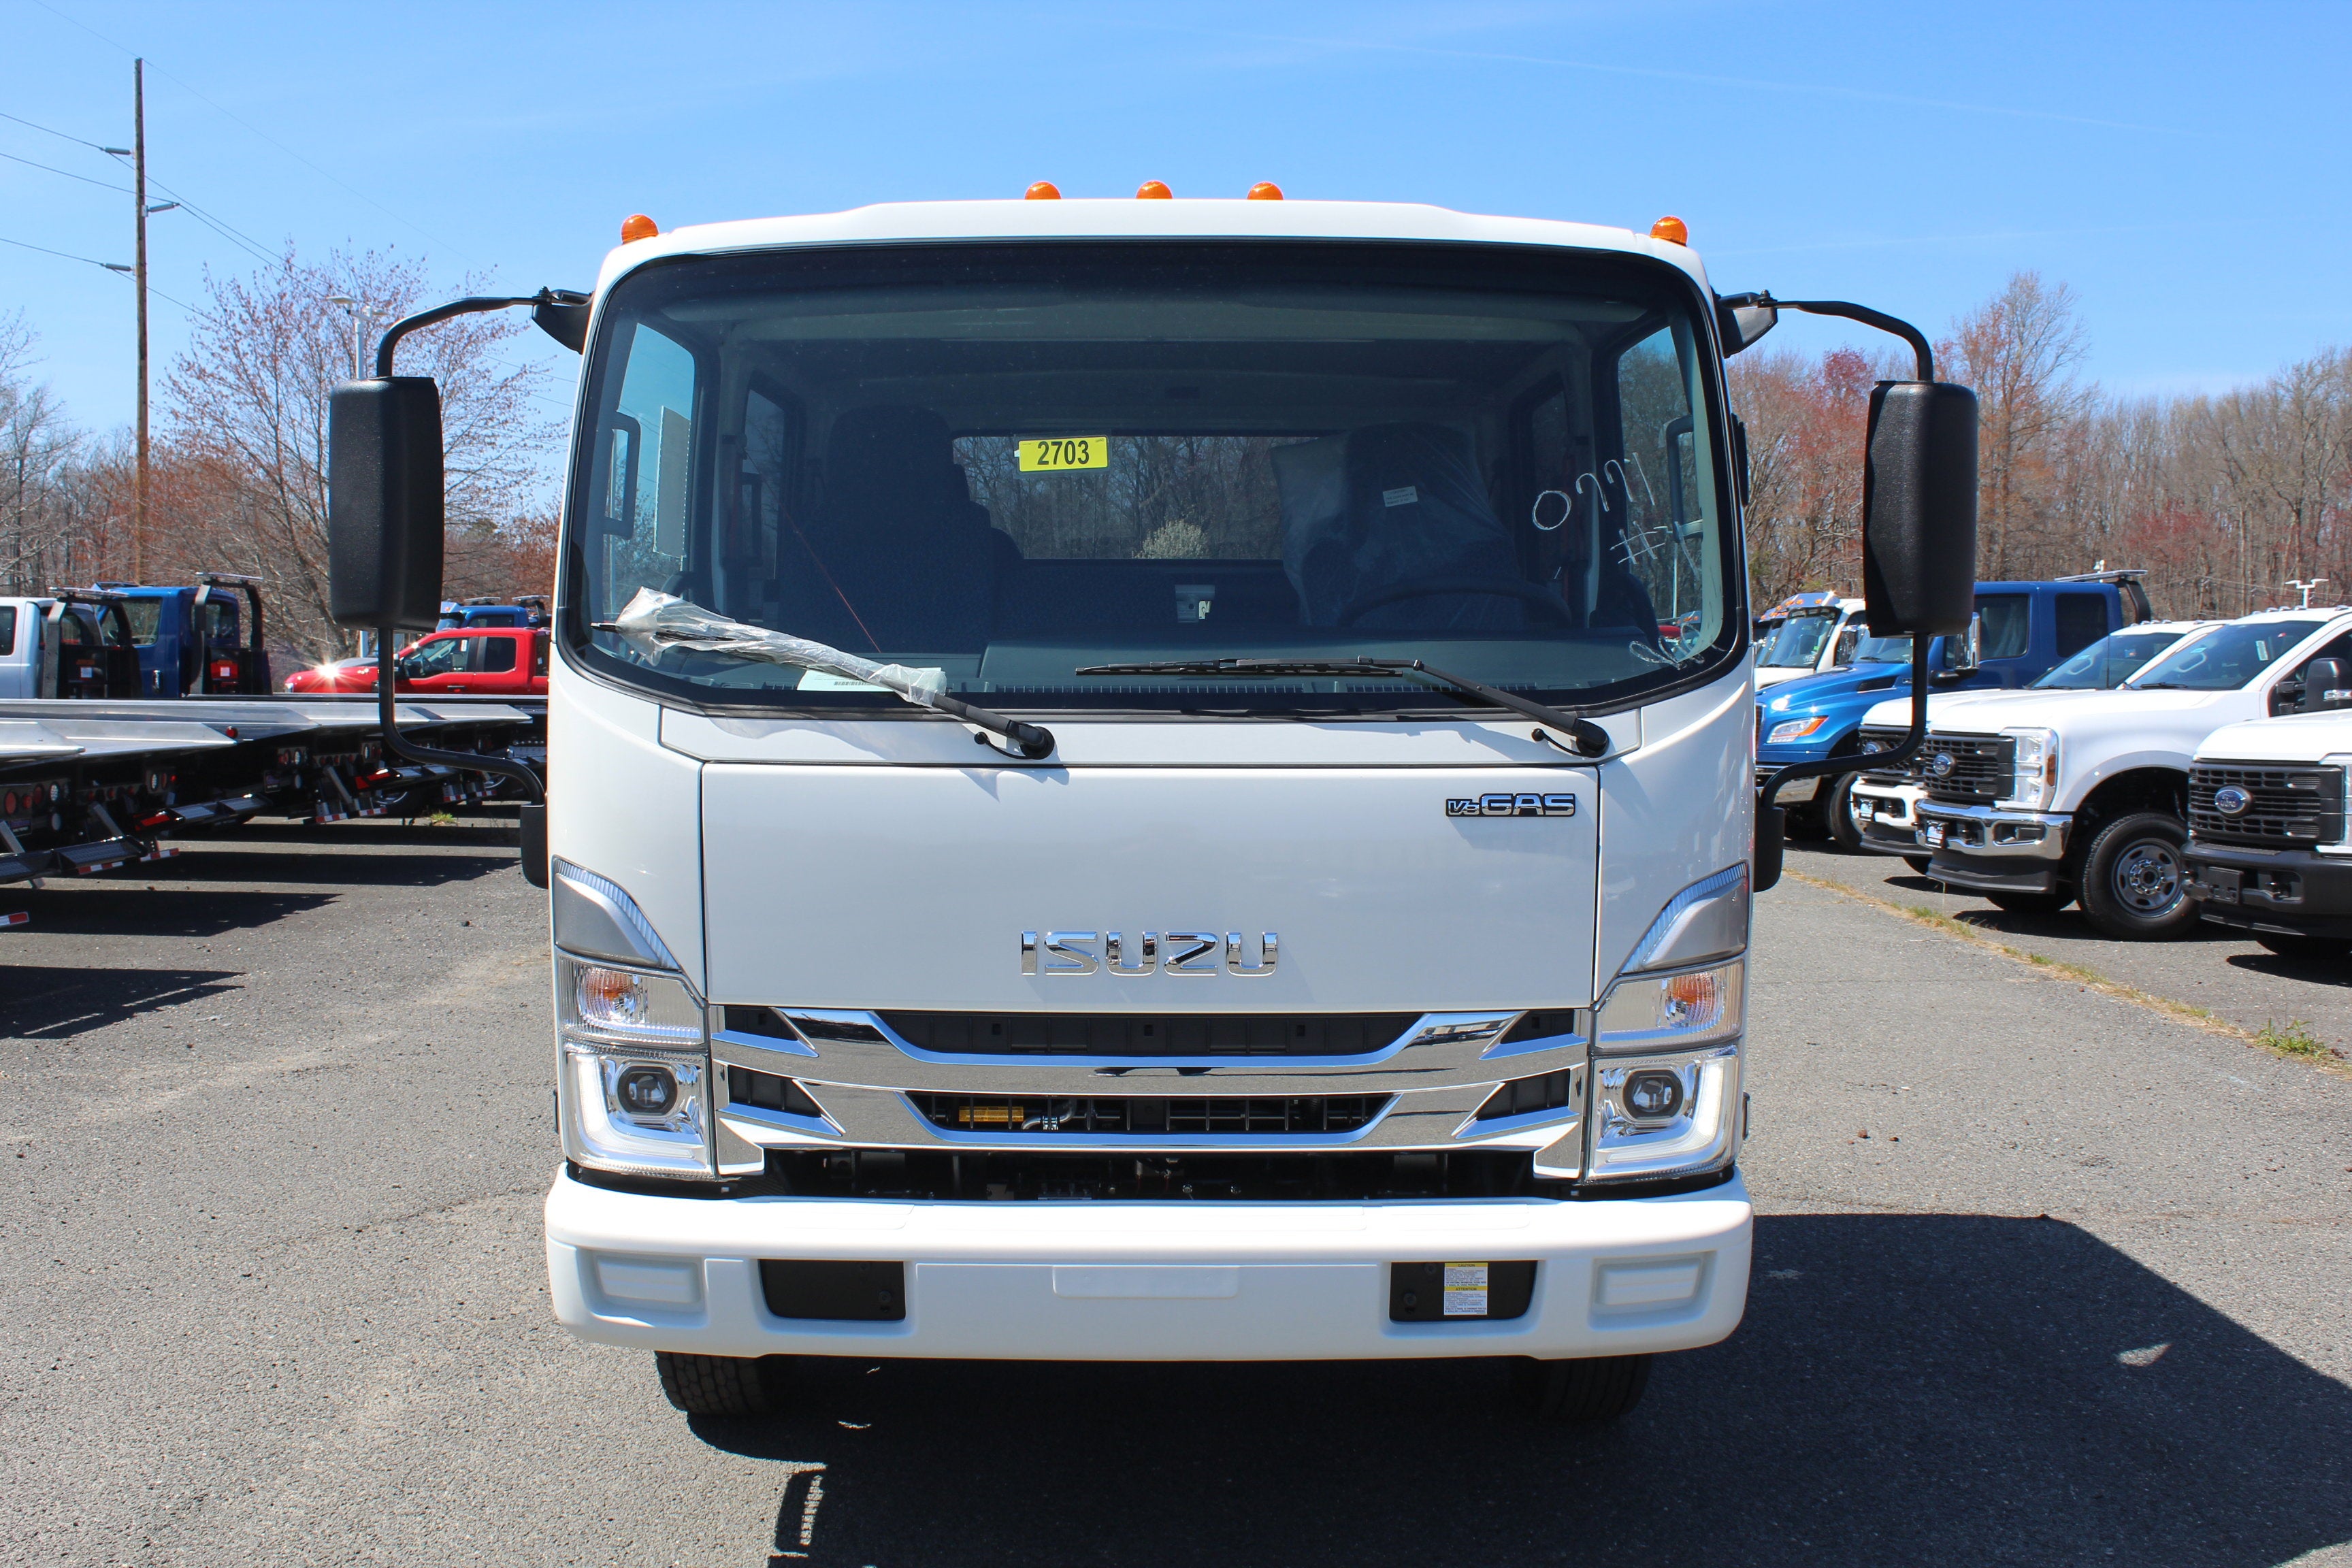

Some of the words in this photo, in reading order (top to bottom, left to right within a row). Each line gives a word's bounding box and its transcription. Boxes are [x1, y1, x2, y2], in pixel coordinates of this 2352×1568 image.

[1036, 440, 1090, 466] 2703
[1480, 794, 1575, 816] GAS
[1020, 930, 1279, 977] ISUZU
